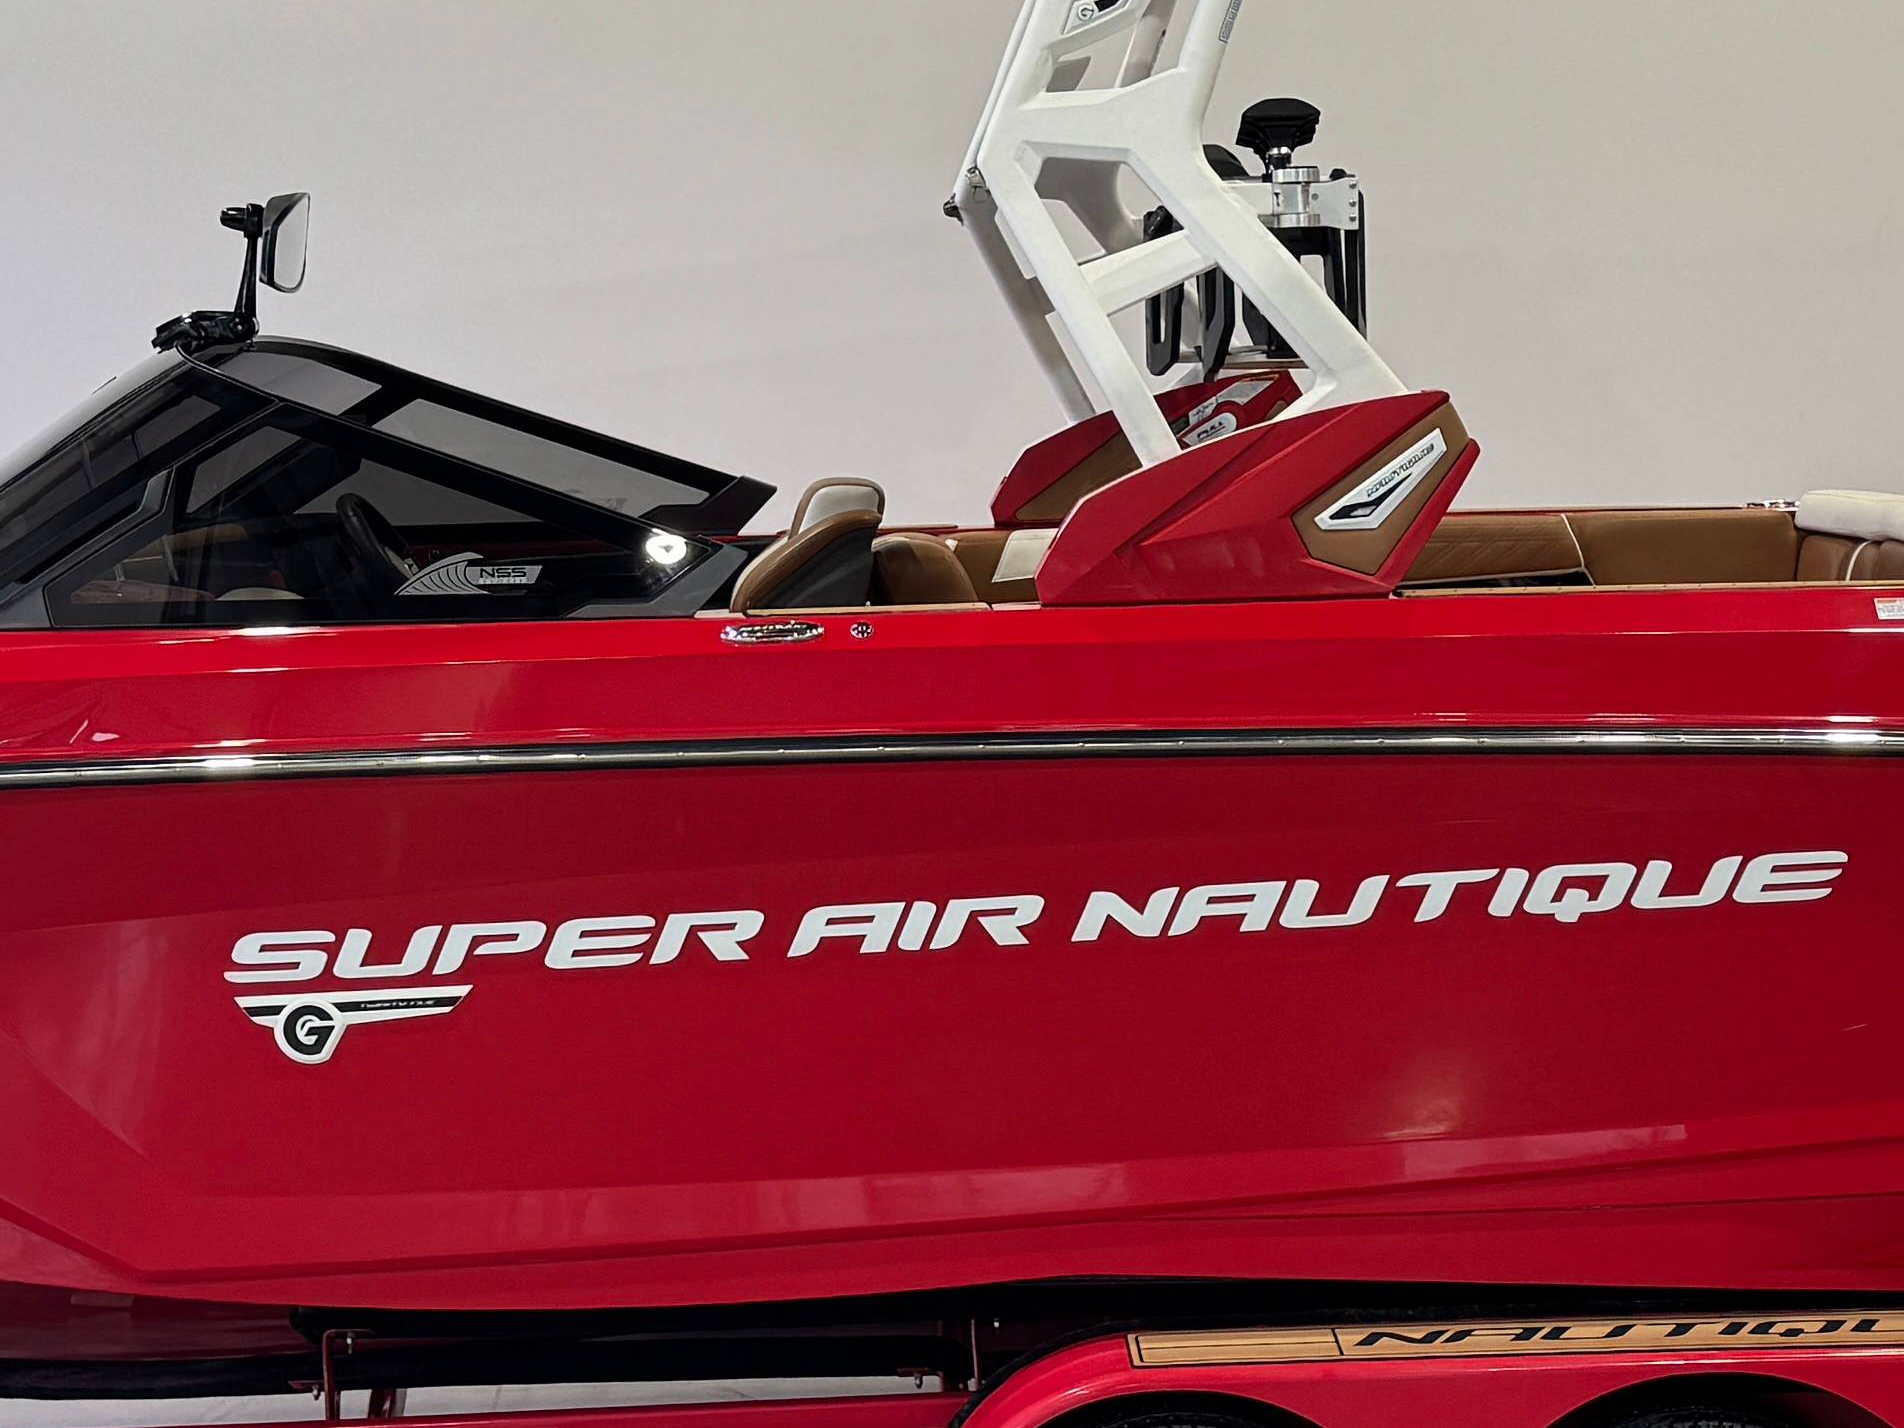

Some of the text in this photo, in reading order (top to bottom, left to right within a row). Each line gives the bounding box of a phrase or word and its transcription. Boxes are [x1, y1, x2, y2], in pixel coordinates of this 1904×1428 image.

[479, 567, 527, 579] NSS
[223, 849, 1851, 985] SUPER AIR NAUTIQUE
[283, 1004, 337, 1056] G
